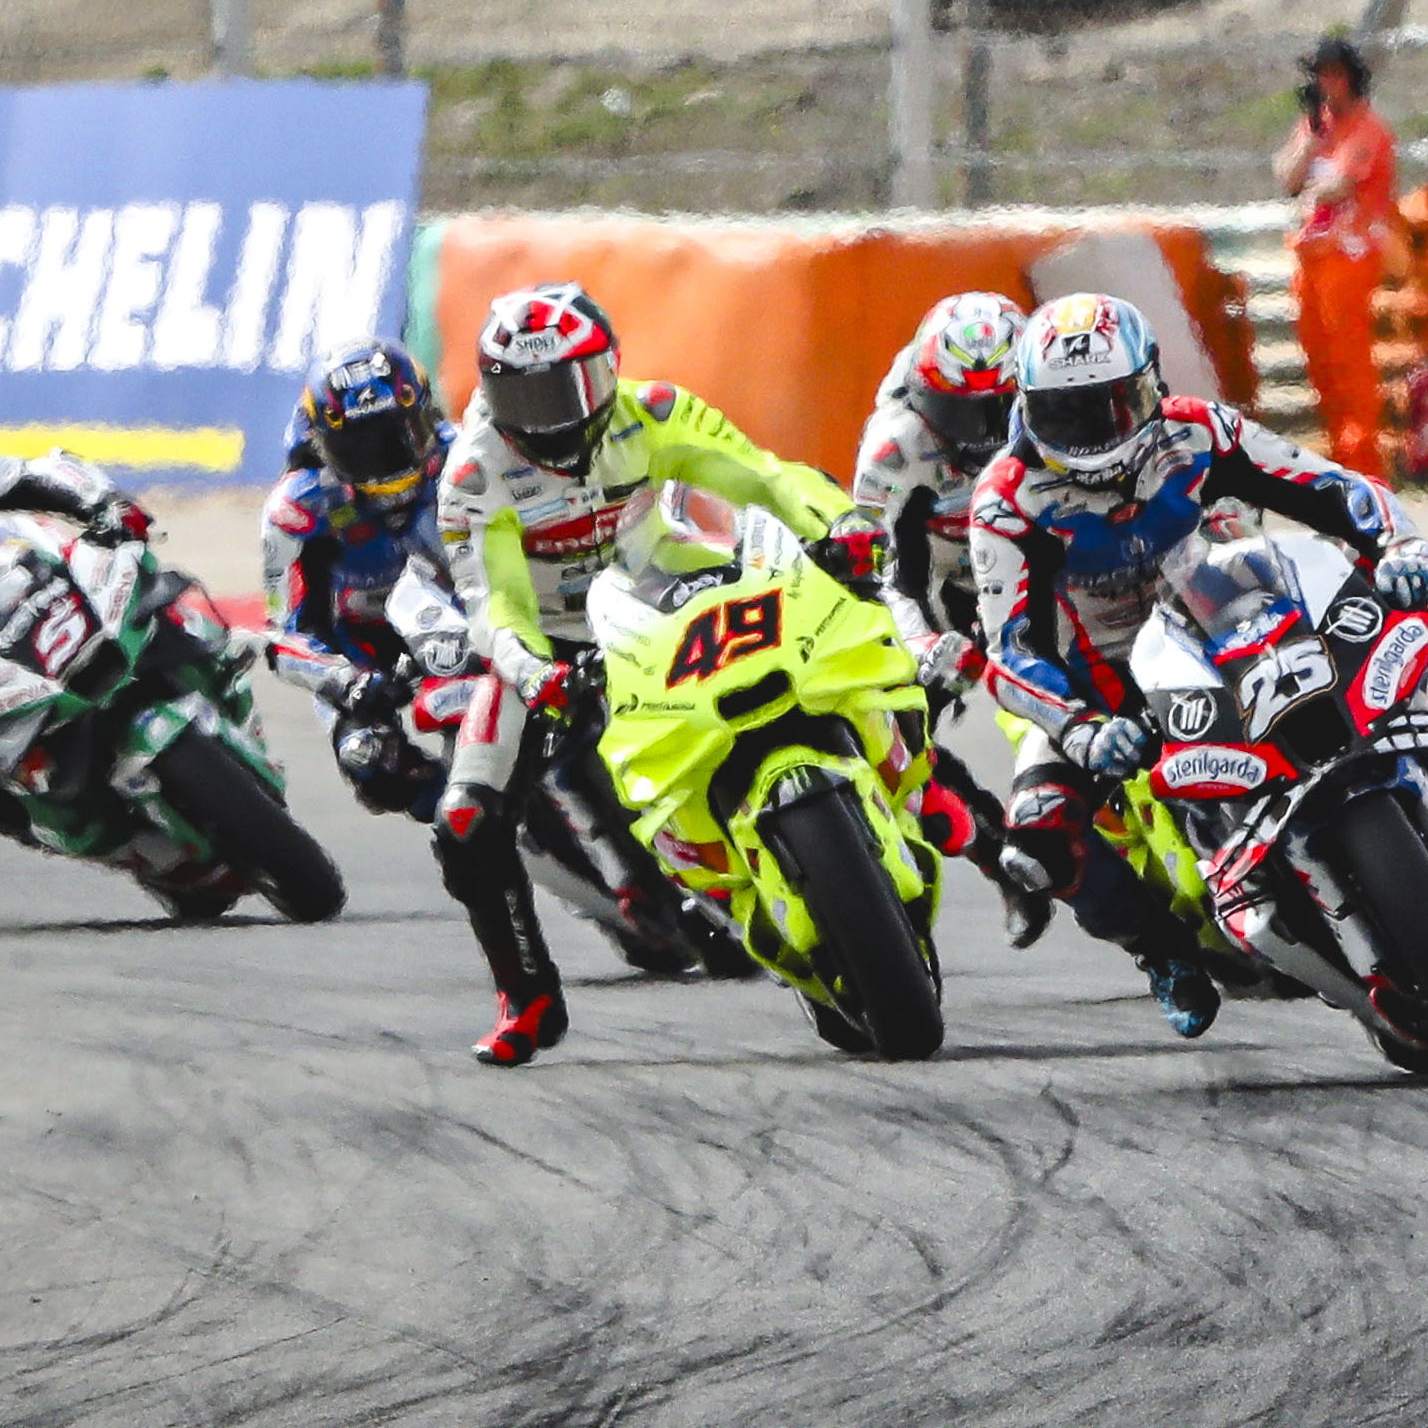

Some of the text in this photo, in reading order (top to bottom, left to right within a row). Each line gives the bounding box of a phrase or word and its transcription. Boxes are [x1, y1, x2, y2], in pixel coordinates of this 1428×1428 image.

[665, 588, 783, 692] 49
[1370, 624, 1425, 703] sterilgarda
[1237, 634, 1337, 747] 25
[1168, 750, 1260, 783] sterilgarda
